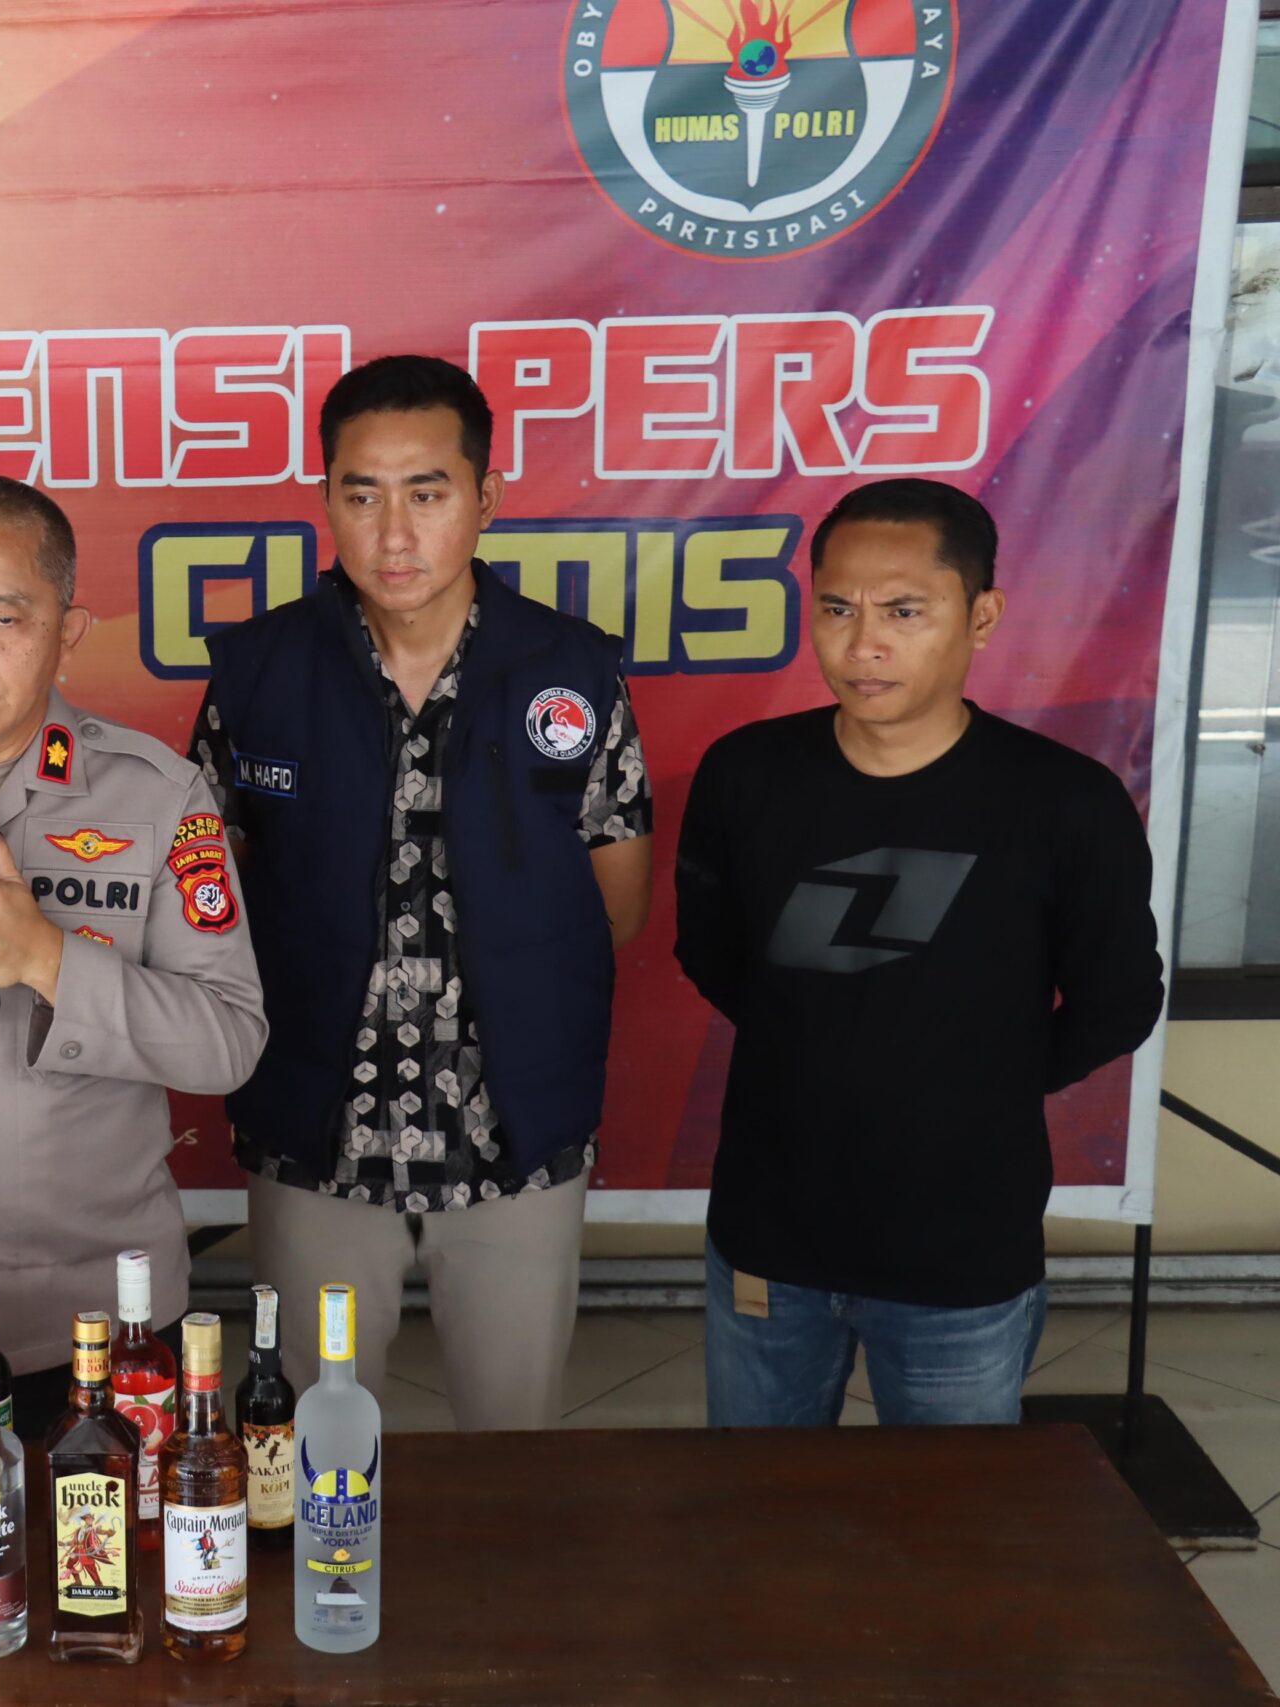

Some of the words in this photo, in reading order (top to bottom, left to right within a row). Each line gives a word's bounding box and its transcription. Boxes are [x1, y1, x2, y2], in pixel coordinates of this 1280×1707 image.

[655, 114, 739, 143] HUMAS
[774, 109, 856, 140] POLRI
[638, 188, 866, 250] PARTISIPASI
[468, 305, 995, 481] PERS
[137, 513, 803, 681] CIMIS
[534, 735, 559, 756] POLRES
[560, 745, 584, 757] CIAMIS
[240, 759, 252, 782] M.
[254, 763, 292, 790] HAFID
[31, 876, 140, 911] POLRI
[61, 1480, 120, 1510] hook
[69, 1480, 102, 1492] uncle
[260, 1483, 290, 1495] KOPI
[166, 1509, 205, 1534] Captain
[209, 1510, 246, 1533] Morgan
[301, 1498, 377, 1529] ICELAND
[322, 1537, 360, 1548] VODKA
[324, 1565, 356, 1574] CITRUS
[71, 1587, 92, 1596] DARK
[93, 1587, 114, 1598] GOLD
[174, 1579, 214, 1595] Spiced
[216, 1575, 241, 1594] Gold
